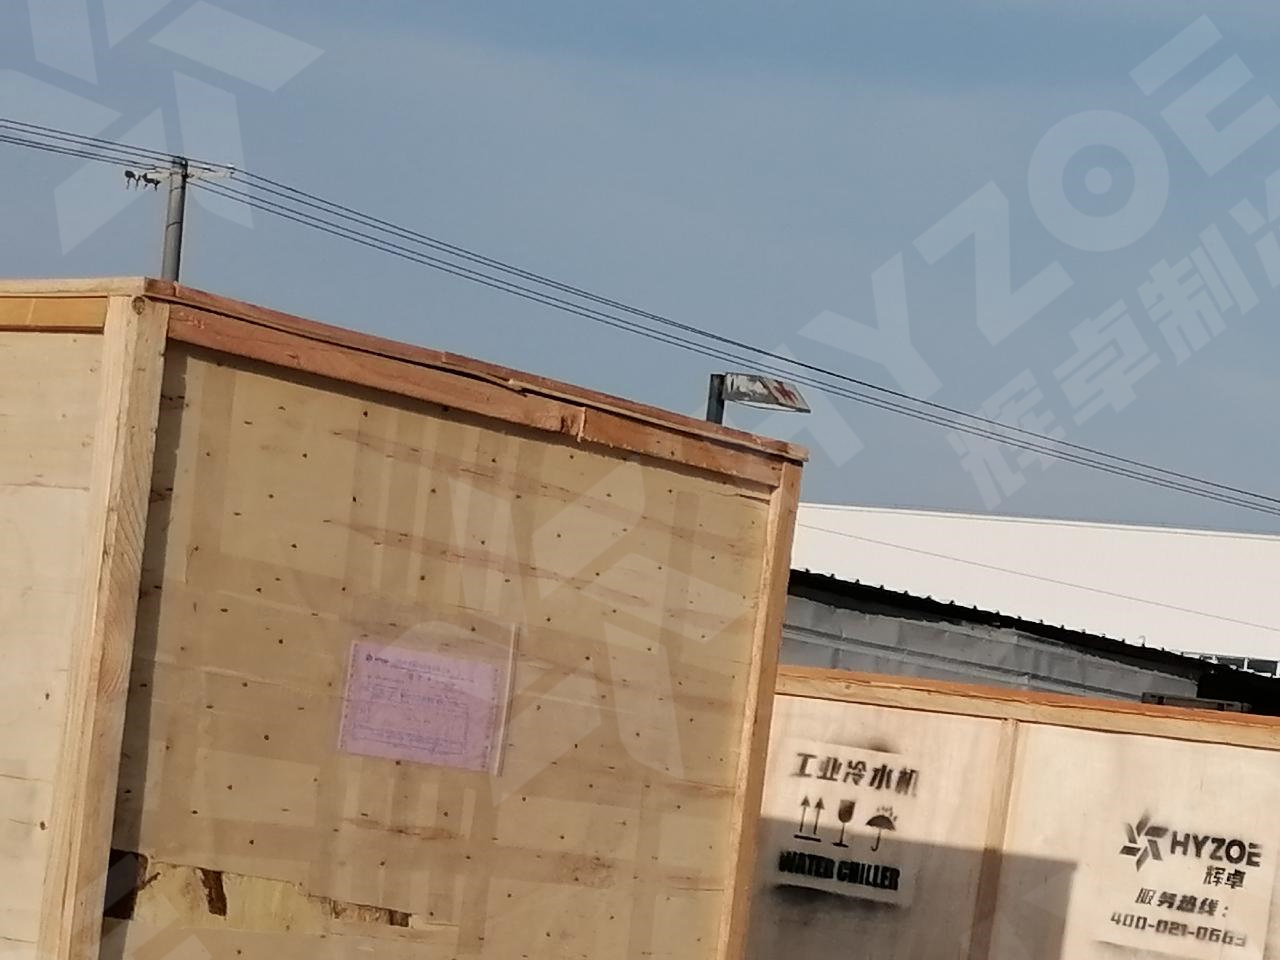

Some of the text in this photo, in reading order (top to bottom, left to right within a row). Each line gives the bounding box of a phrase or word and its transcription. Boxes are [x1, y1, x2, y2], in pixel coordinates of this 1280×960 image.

[791, 752, 920, 797] 工业冷水机
[1170, 830, 1263, 867] HYZOE
[837, 860, 900, 891] CHILLER
[1203, 865, 1247, 889] 辉卓
[1110, 912, 1248, 948] 400-021-0663
